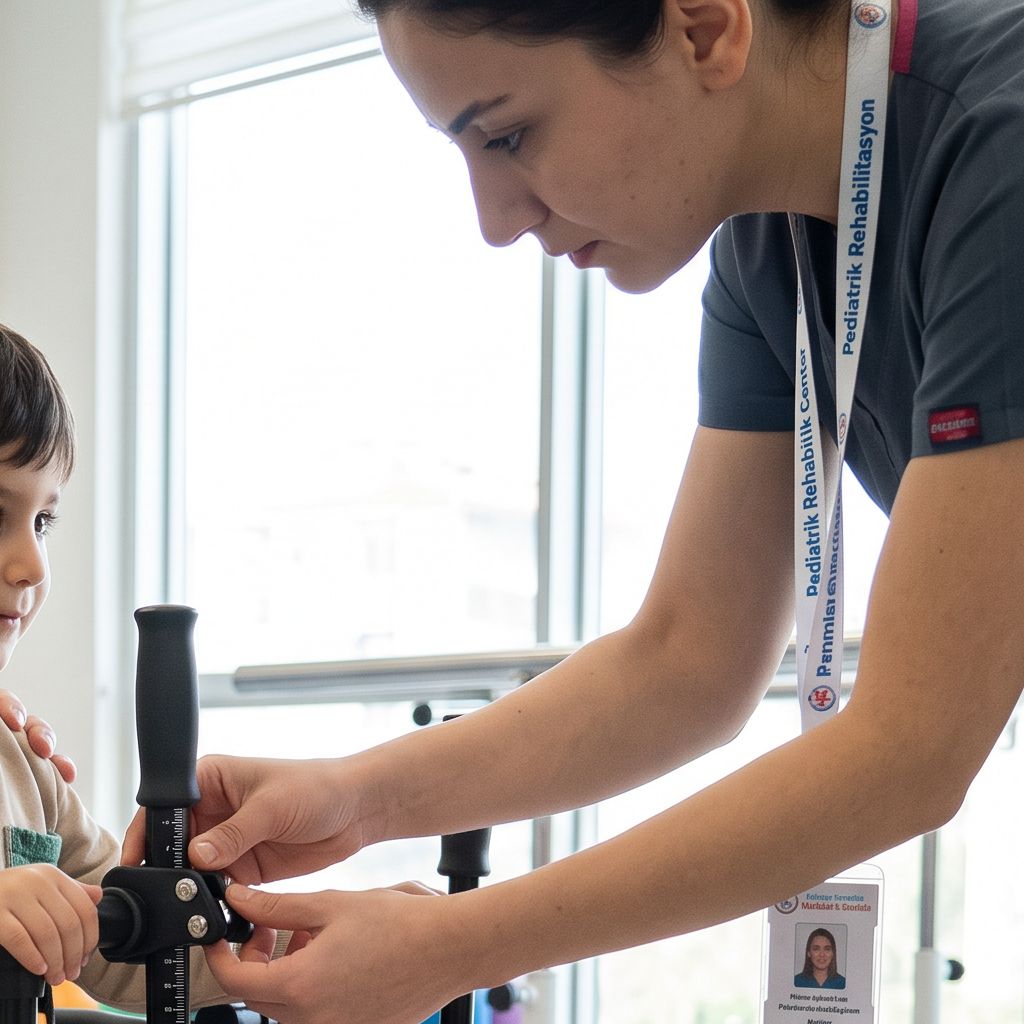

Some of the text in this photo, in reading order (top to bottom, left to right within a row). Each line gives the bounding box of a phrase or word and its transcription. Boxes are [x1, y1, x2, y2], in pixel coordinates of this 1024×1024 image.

[842, 98, 878, 356] Pediatrik Rehabilitasyon
[803, 513, 821, 597] Pediatrik
